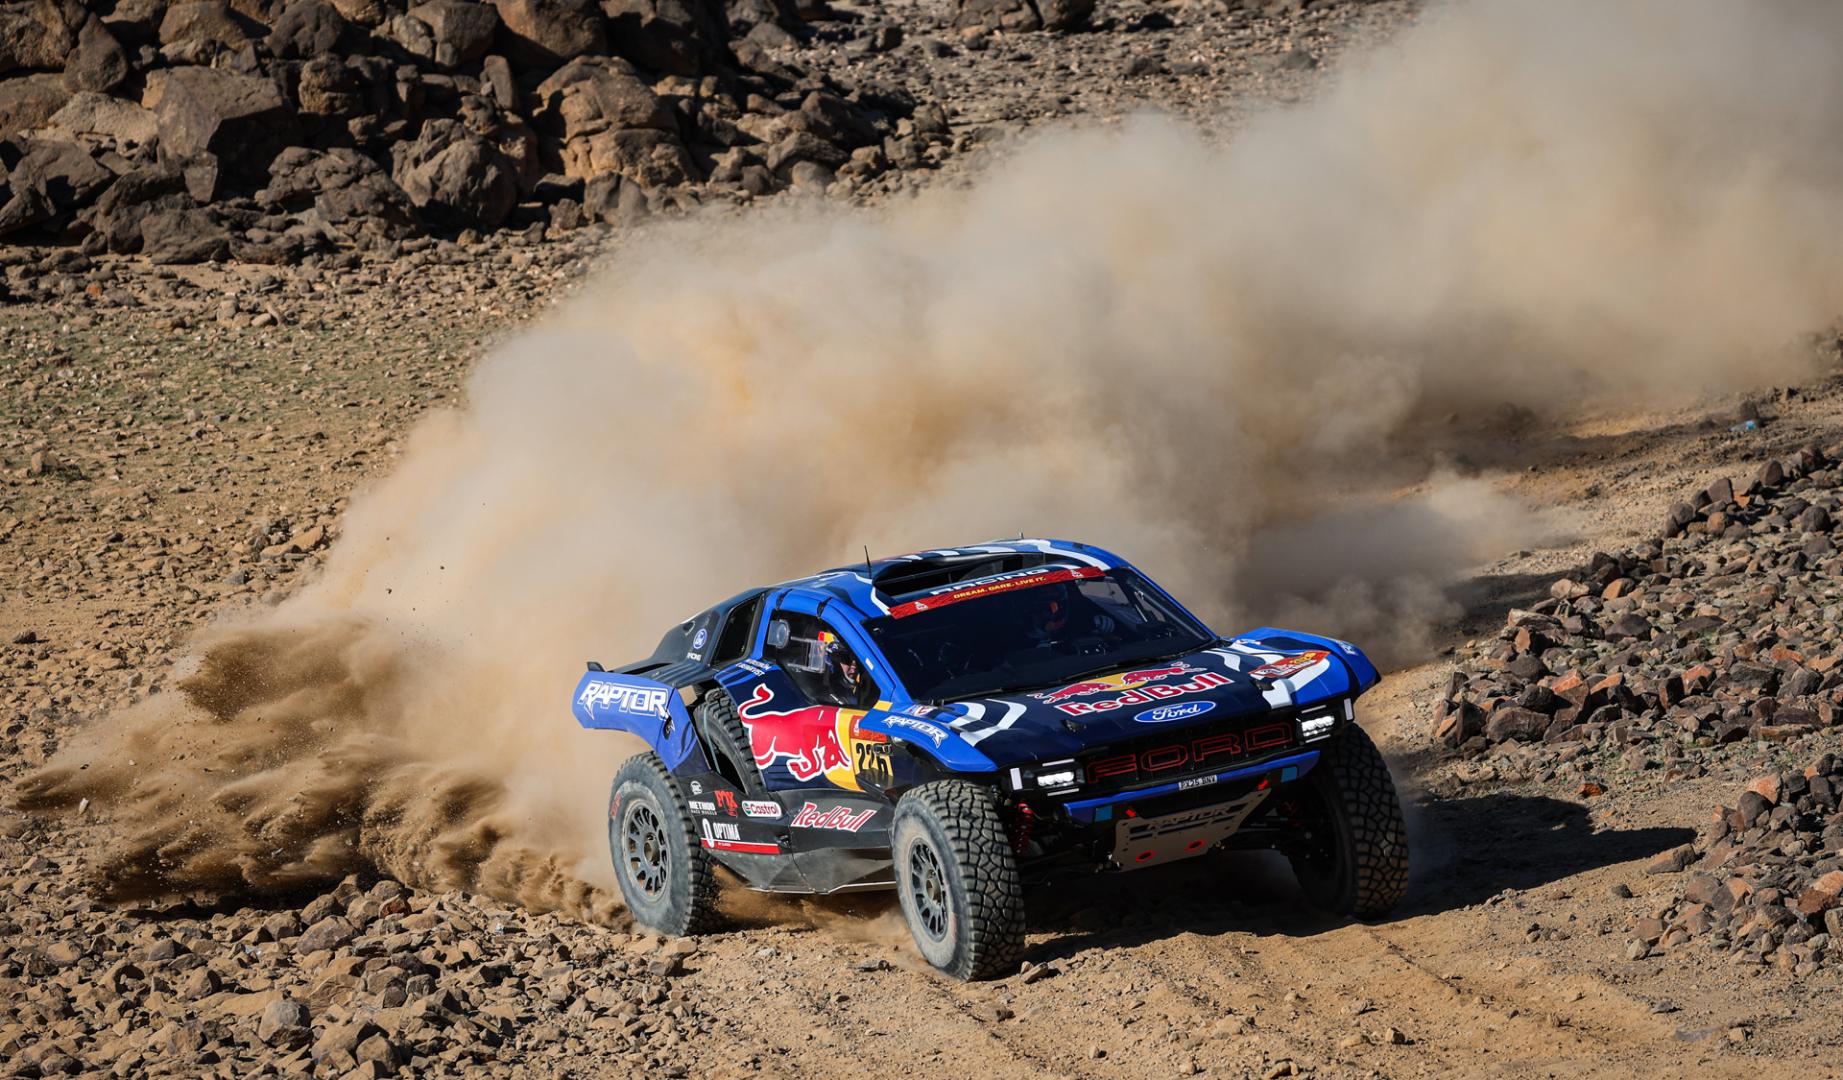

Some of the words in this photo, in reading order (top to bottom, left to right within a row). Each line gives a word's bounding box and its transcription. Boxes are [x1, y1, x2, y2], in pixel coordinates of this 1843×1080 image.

[1015, 578, 1034, 586] LIVE
[577, 680, 675, 731] RAPTOR
[1152, 704, 1201, 720] Ford
[881, 715, 949, 748] RAPTOR
[1087, 722, 1293, 783] FORD
[688, 800, 716, 811] METHOD
[750, 802, 779, 815] Castrol
[712, 822, 740, 840] OPTIMA
